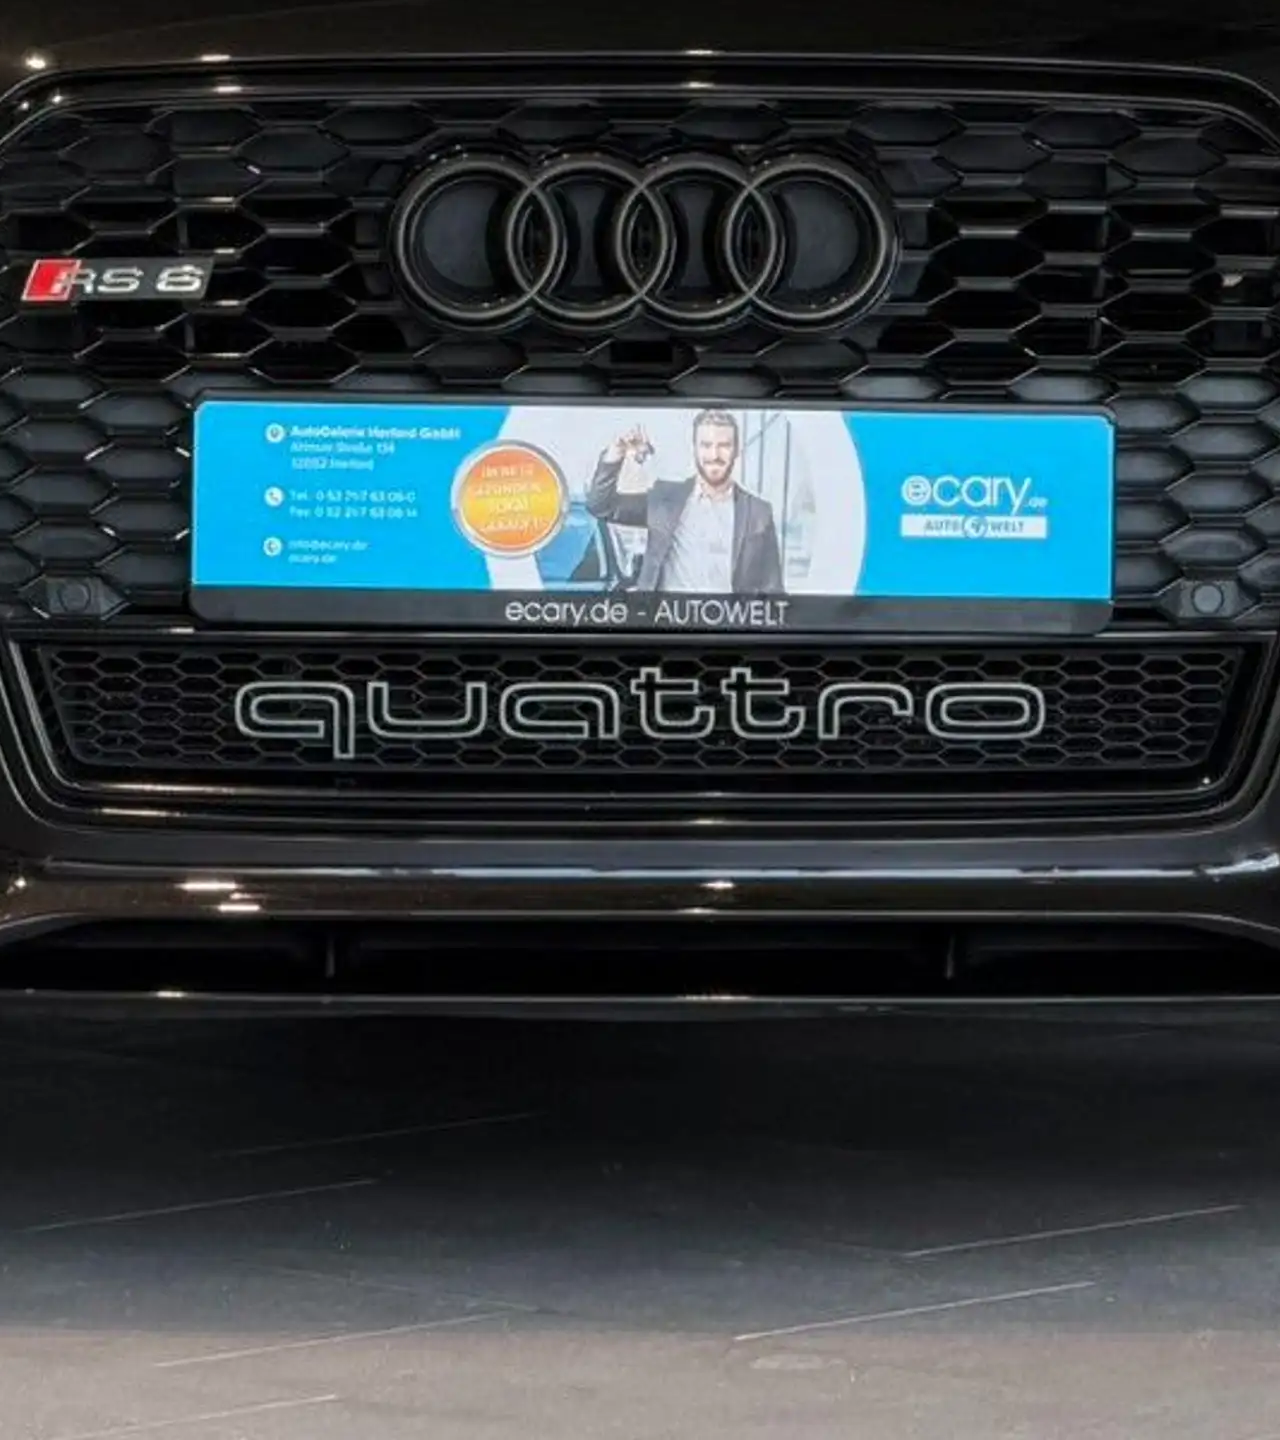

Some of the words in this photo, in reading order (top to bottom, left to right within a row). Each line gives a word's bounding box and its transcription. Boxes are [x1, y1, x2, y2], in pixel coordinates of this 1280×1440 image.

[504, 597, 629, 628] ecary.de
[653, 598, 790, 627] AUTOWELT
[234, 666, 1046, 759] quattro
